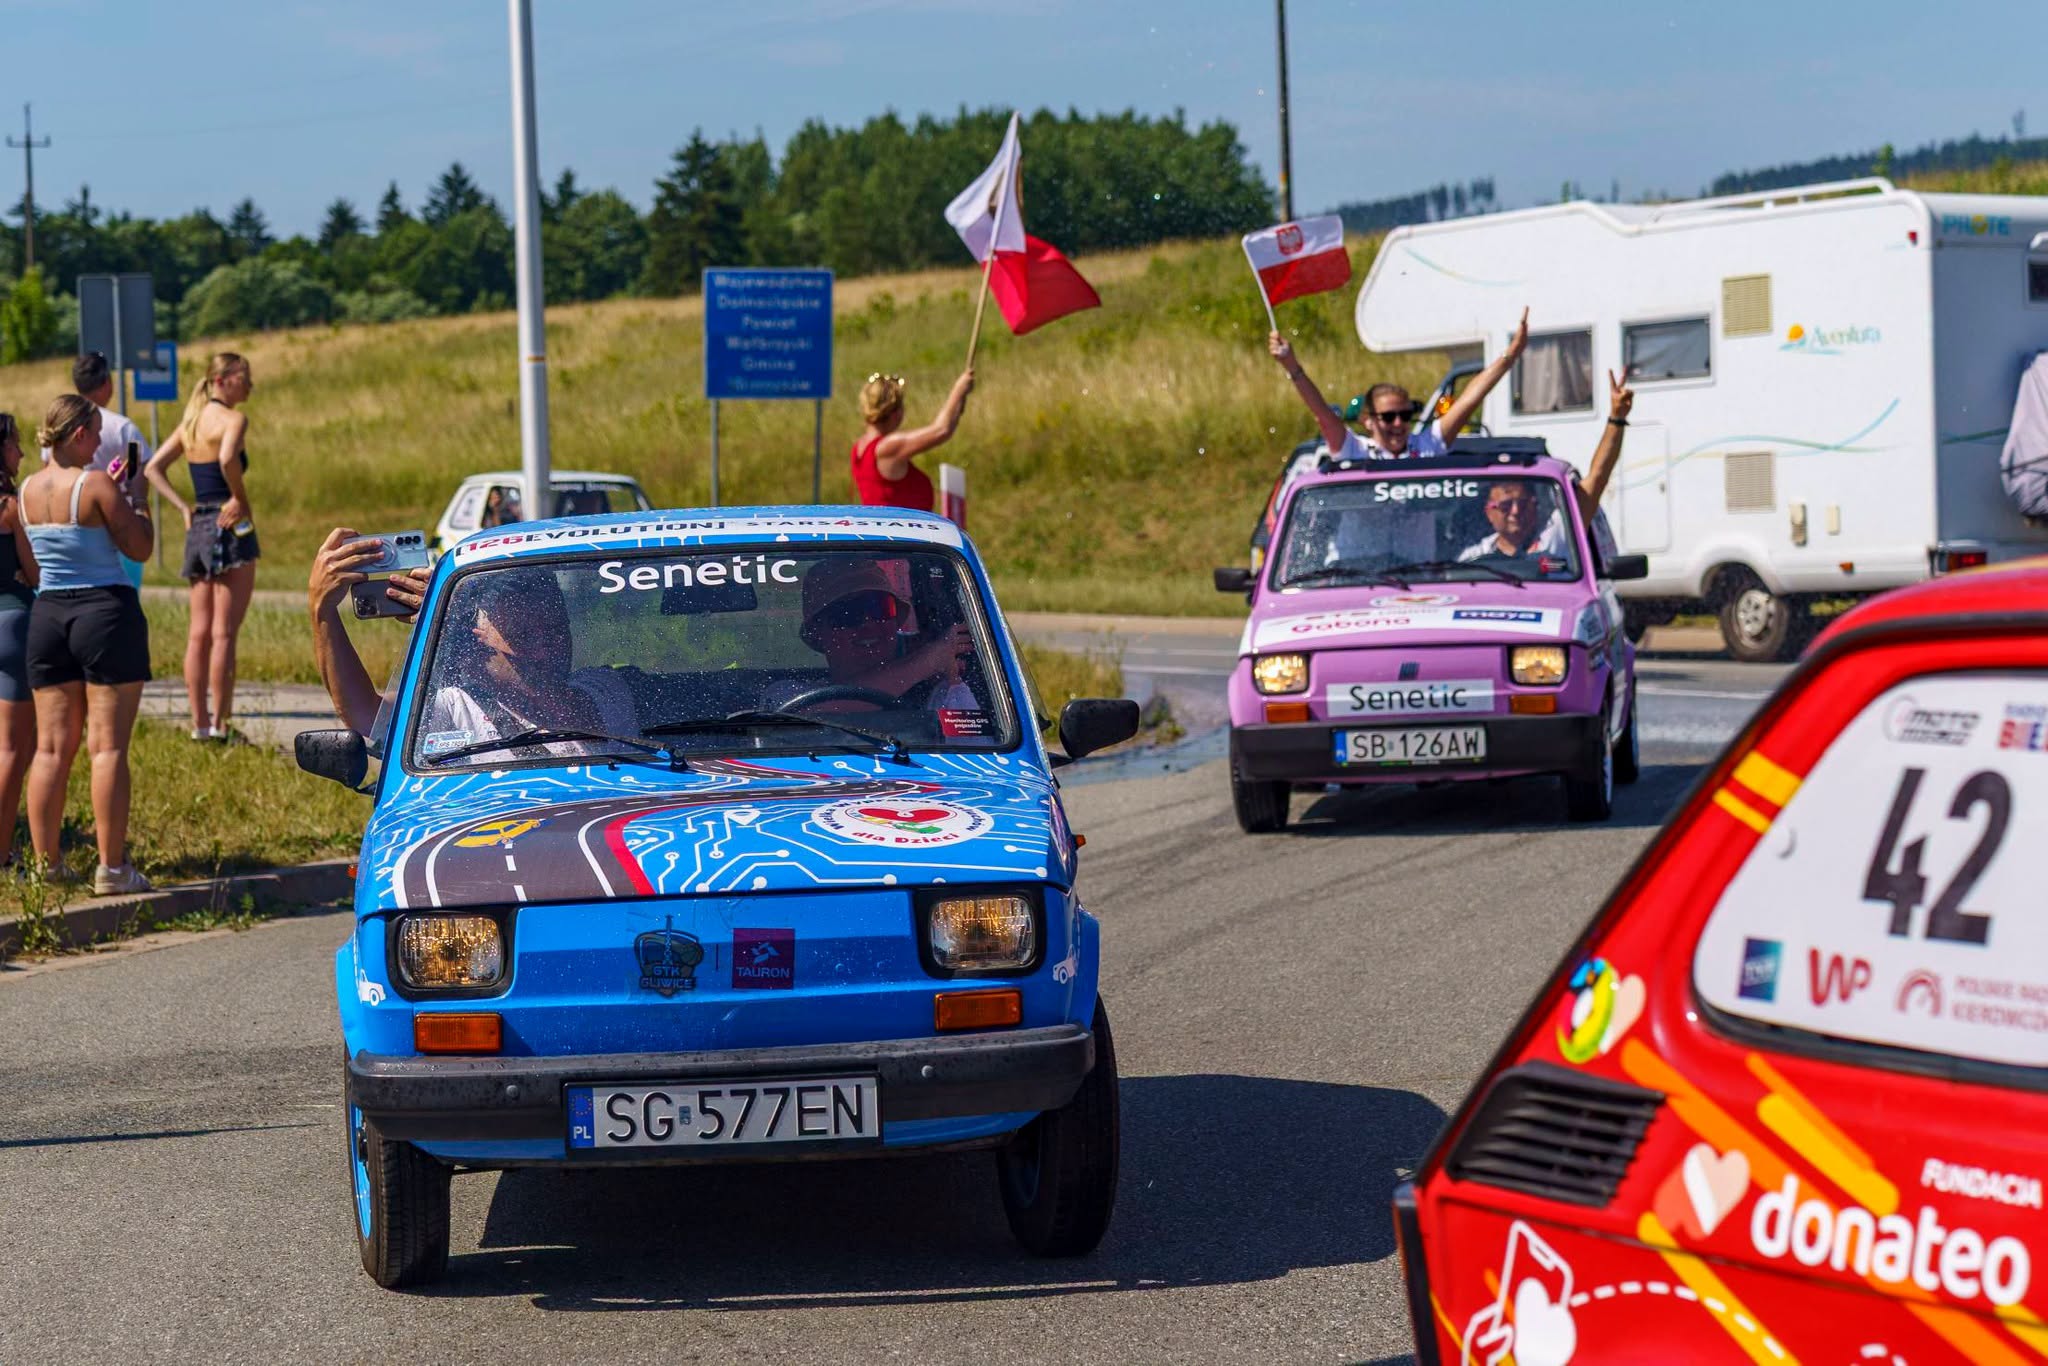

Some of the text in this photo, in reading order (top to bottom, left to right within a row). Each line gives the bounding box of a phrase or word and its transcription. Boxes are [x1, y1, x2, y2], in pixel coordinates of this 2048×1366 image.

[1941, 213, 2012, 236] PILOTE
[1374, 479, 1478, 502] Senetic
[599, 554, 799, 594] Senetic
[1350, 684, 1468, 711] Senetic
[1353, 733, 1386, 759] SB
[1399, 730, 1479, 758] 126AW
[852, 831, 960, 844] dla Dzieci
[1862, 767, 2013, 947] 42
[640, 976, 695, 989] GLIWICE
[736, 966, 790, 978] TAURON
[1808, 947, 1871, 1006] WP
[573, 1084, 863, 1142] PL SG 577EN
[1921, 1158, 2043, 1209] FUNDACJA
[1750, 1173, 2031, 1306] donateo
